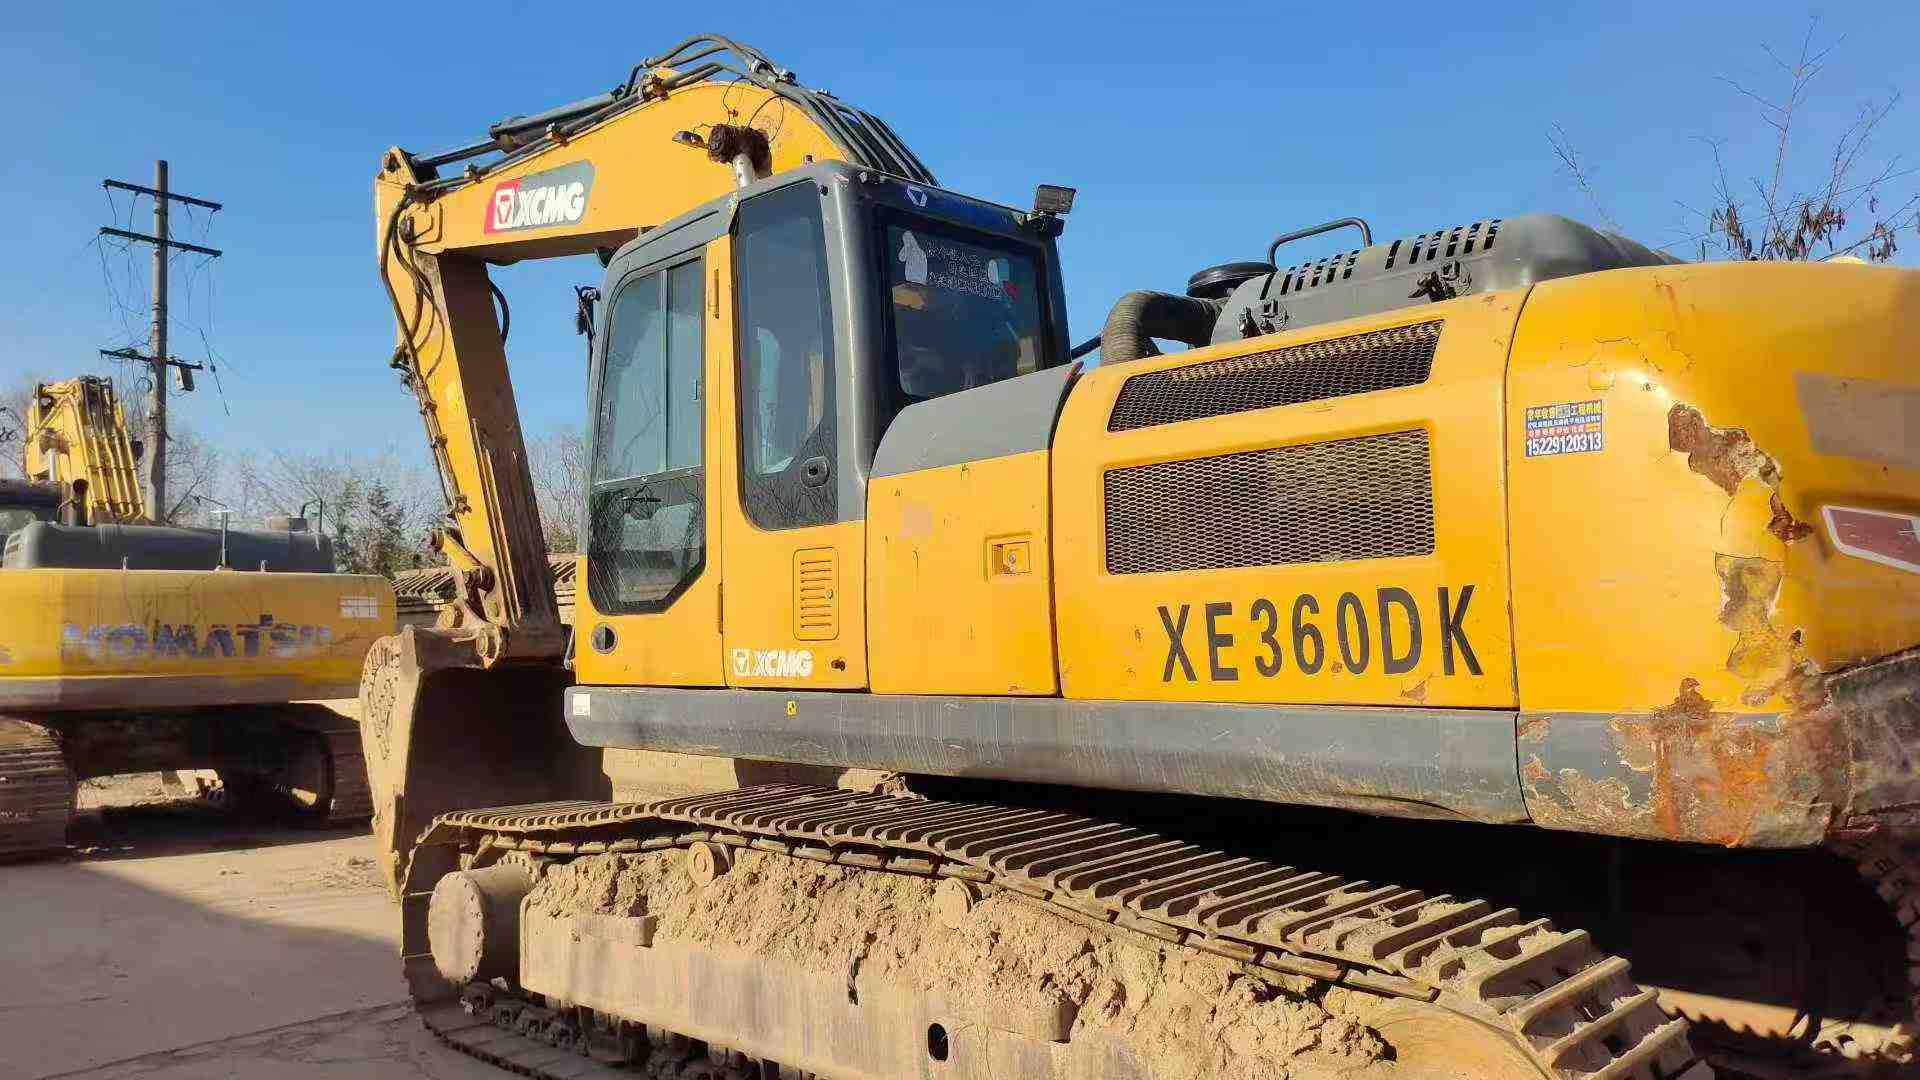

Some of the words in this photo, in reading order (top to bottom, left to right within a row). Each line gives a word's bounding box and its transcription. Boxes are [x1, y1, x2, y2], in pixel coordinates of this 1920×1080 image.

[514, 181, 585, 226] XCMG
[1526, 432, 1602, 457] 15229120313
[1156, 584, 1485, 683] XE360DK
[752, 649, 815, 677] XCMG
